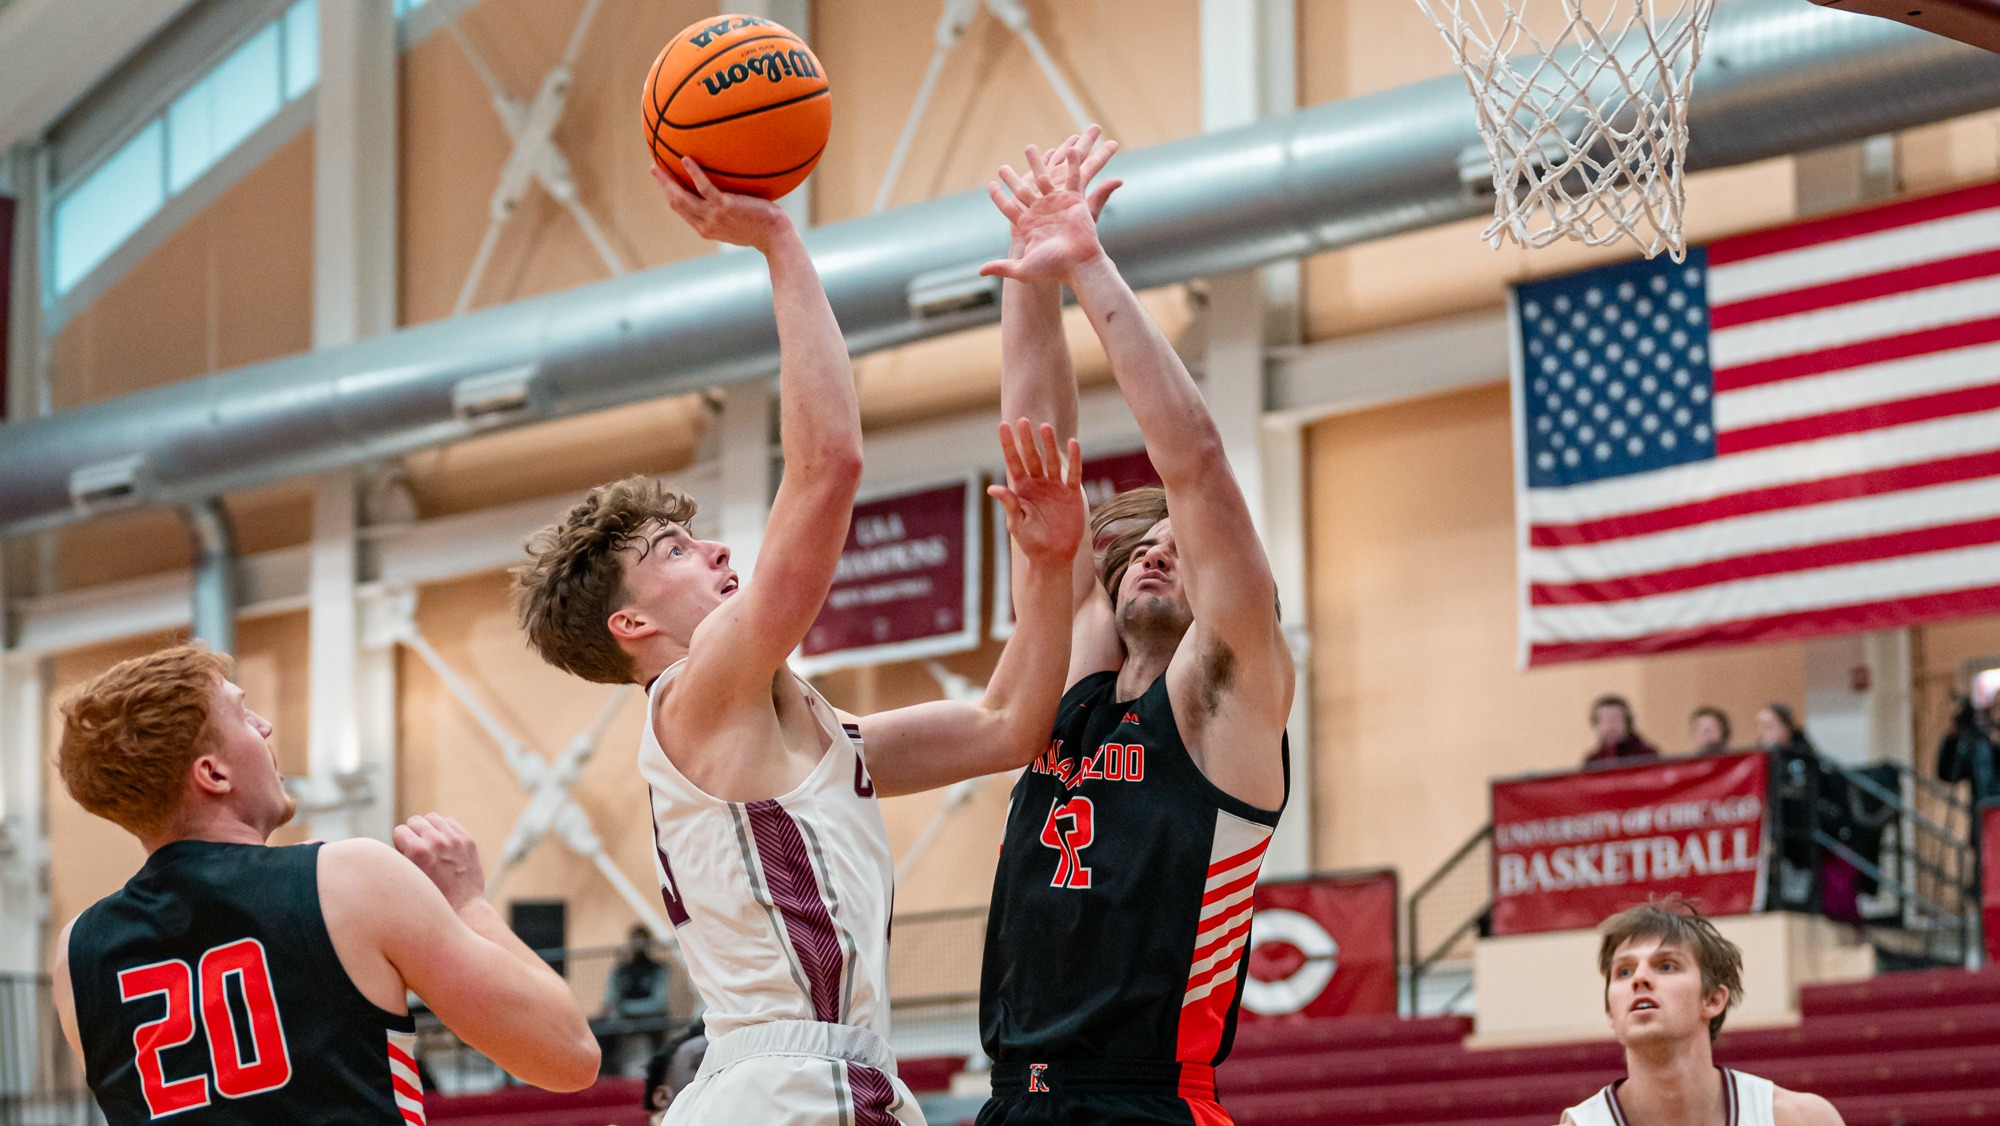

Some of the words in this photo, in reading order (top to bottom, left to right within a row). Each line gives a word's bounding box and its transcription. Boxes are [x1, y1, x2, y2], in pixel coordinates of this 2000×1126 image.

[702, 49, 819, 95] Wilson
[1040, 796, 1095, 889] 42
[1496, 811, 1620, 847] UNIVERSITY
[1622, 806, 1651, 834] OF
[1654, 795, 1762, 829] CHICAGO
[1499, 828, 1758, 897] BASKETBALL
[117, 937, 292, 1120] 20
